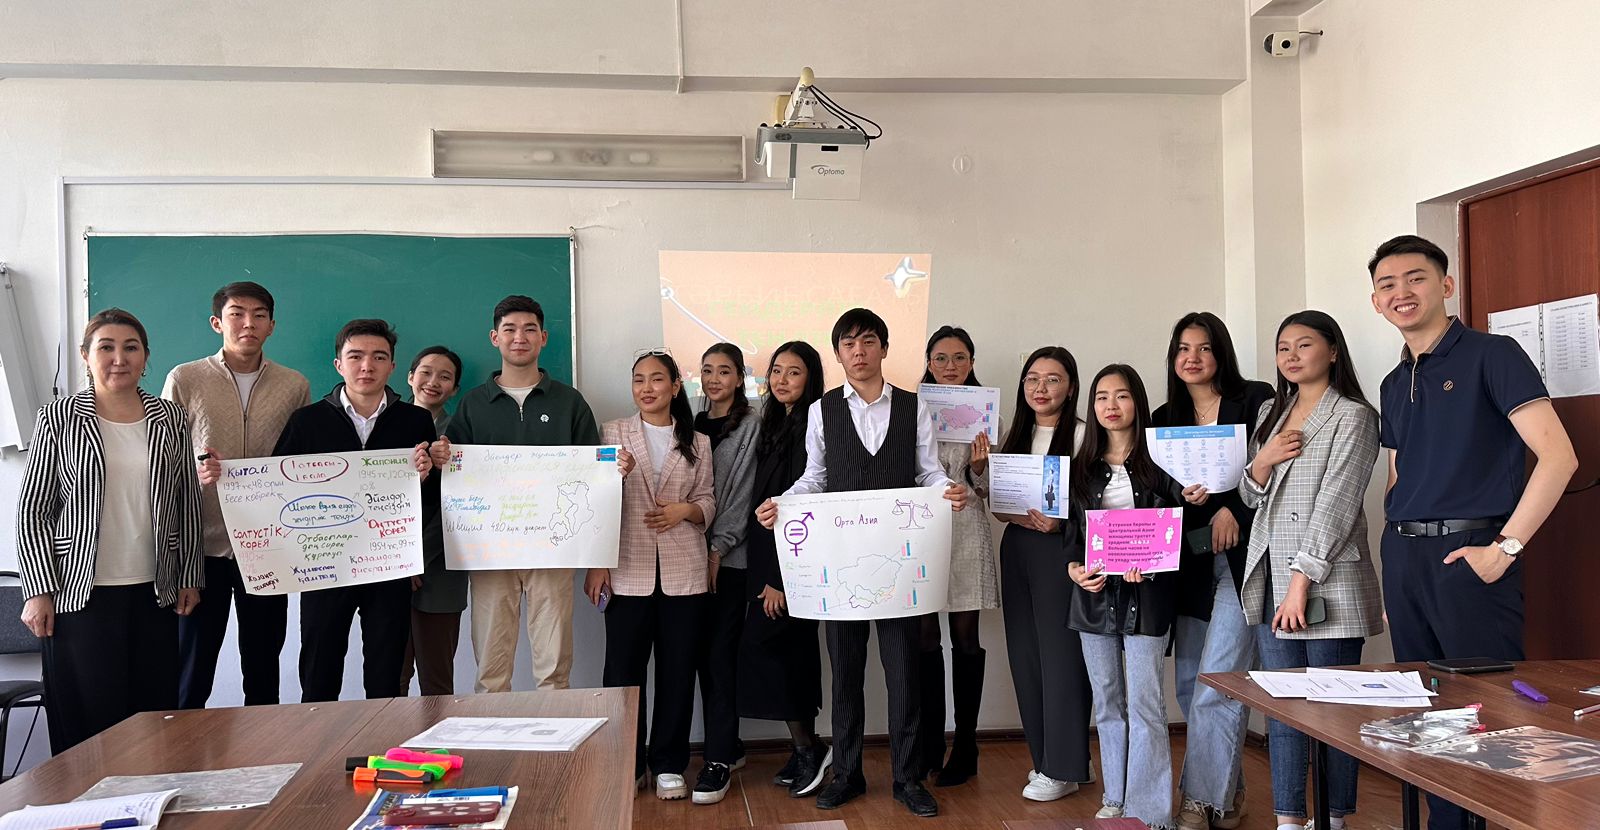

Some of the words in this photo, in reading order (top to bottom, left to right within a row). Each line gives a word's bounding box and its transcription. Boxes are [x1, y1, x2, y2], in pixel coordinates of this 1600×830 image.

[818, 167, 845, 176] Optoma
[361, 457, 408, 467] Жапония
[834, 516, 854, 528] Орта
[858, 514, 878, 525] Азия
